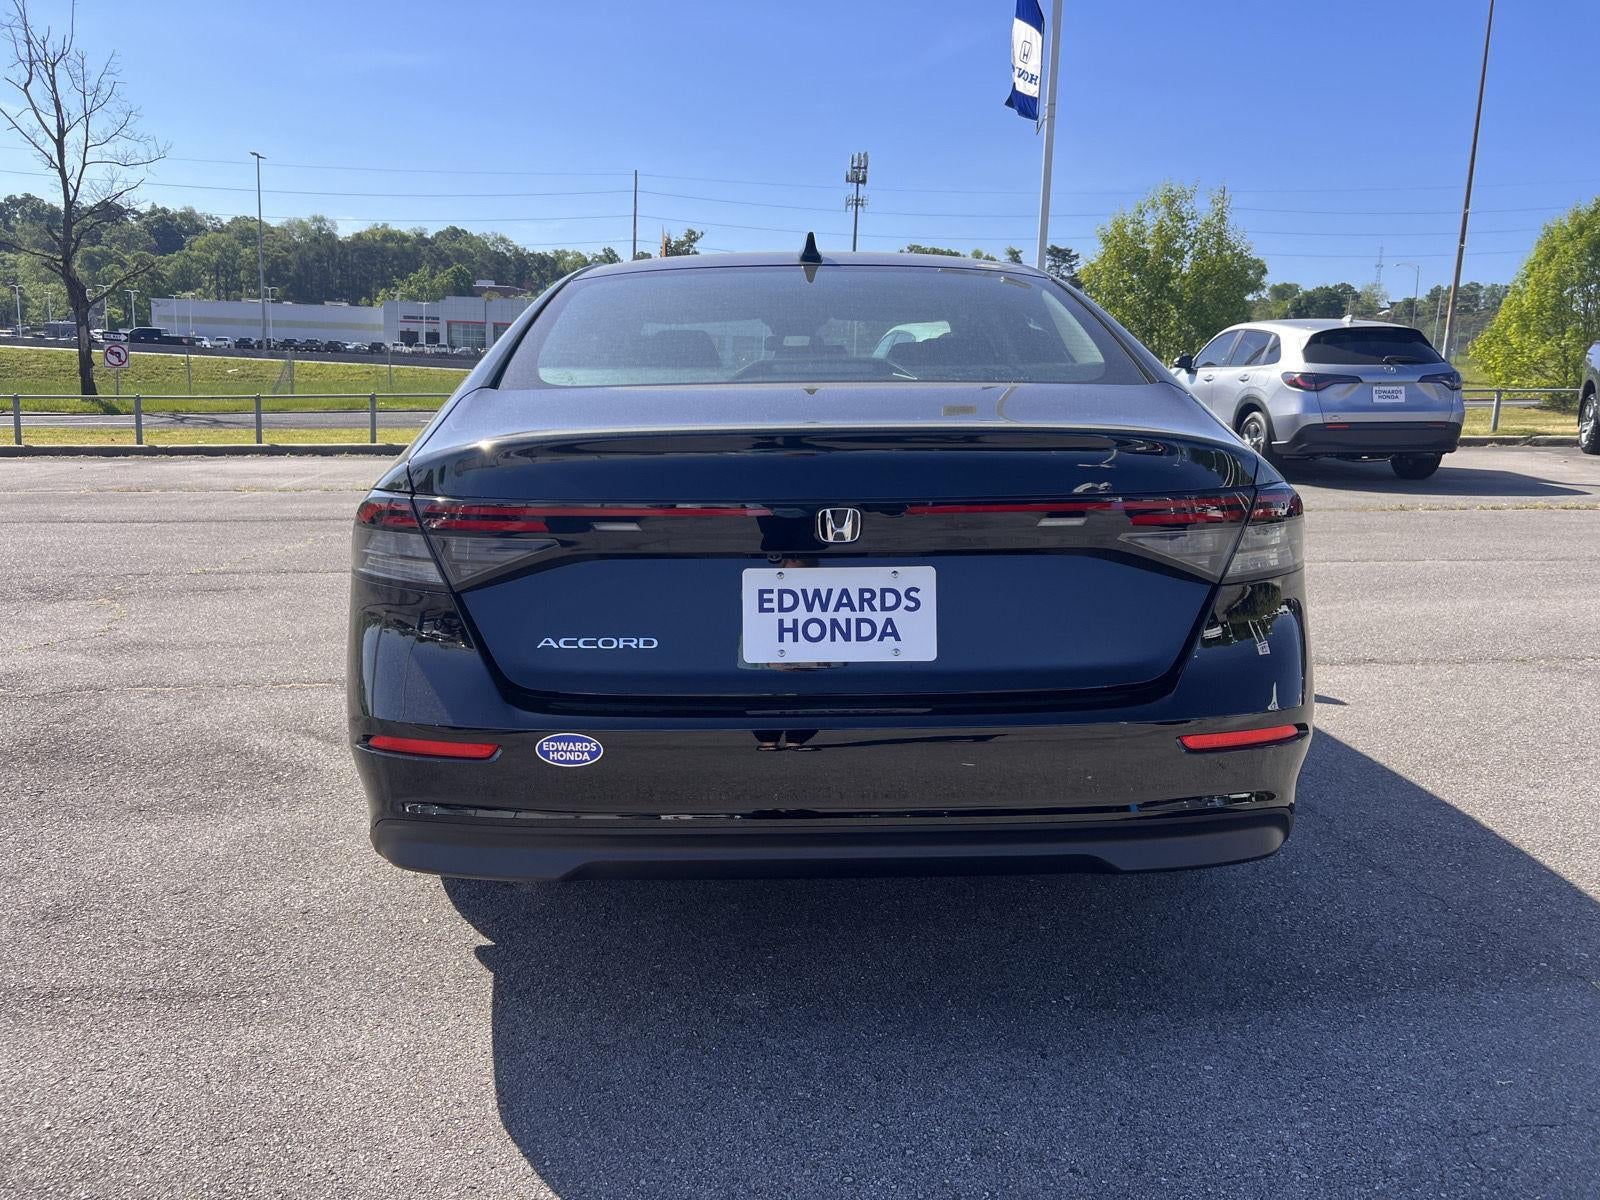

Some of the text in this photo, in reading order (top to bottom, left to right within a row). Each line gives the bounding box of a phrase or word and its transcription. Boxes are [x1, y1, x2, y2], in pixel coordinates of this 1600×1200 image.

[758, 586, 921, 613] EDWARDS
[777, 617, 902, 643] HONDA
[537, 637, 658, 649] ACCORD
[542, 741, 597, 752] EDWARDS
[549, 751, 591, 761] HONDA
